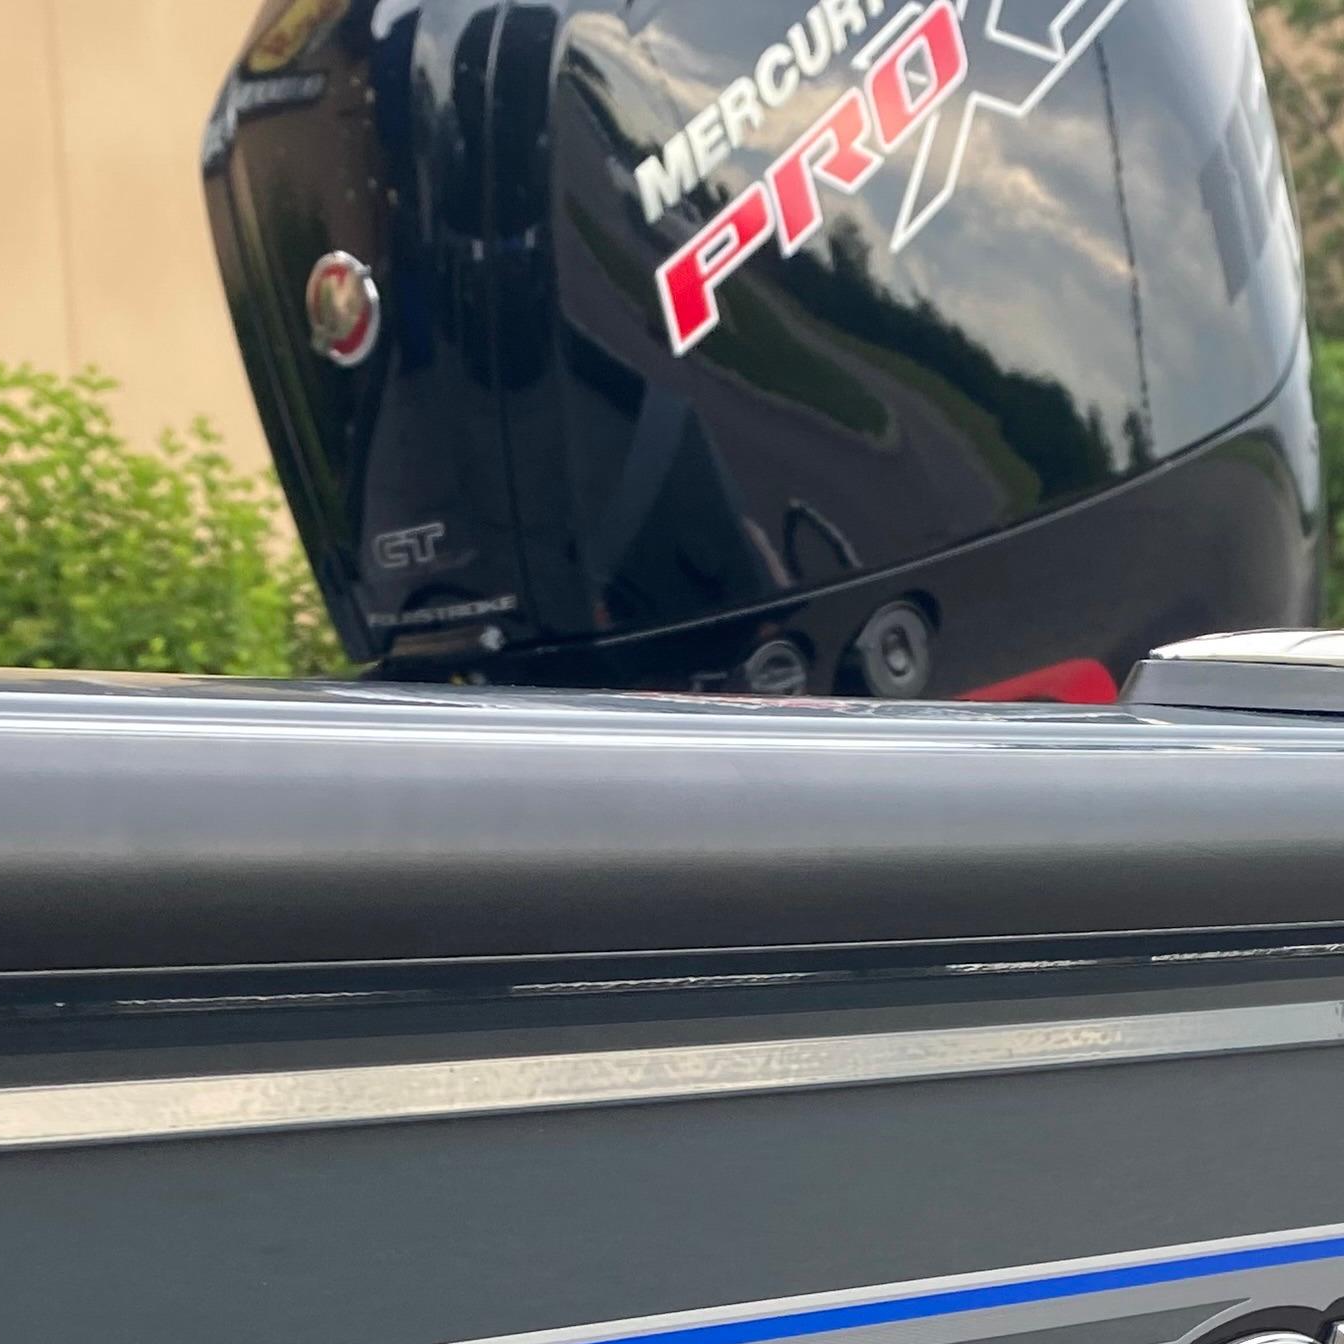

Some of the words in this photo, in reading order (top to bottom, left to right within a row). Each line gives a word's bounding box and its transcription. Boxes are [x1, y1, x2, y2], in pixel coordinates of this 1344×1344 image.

[634, 0, 885, 223] MERCUR
[656, 0, 969, 356] PRO
[372, 522, 445, 569] GT
